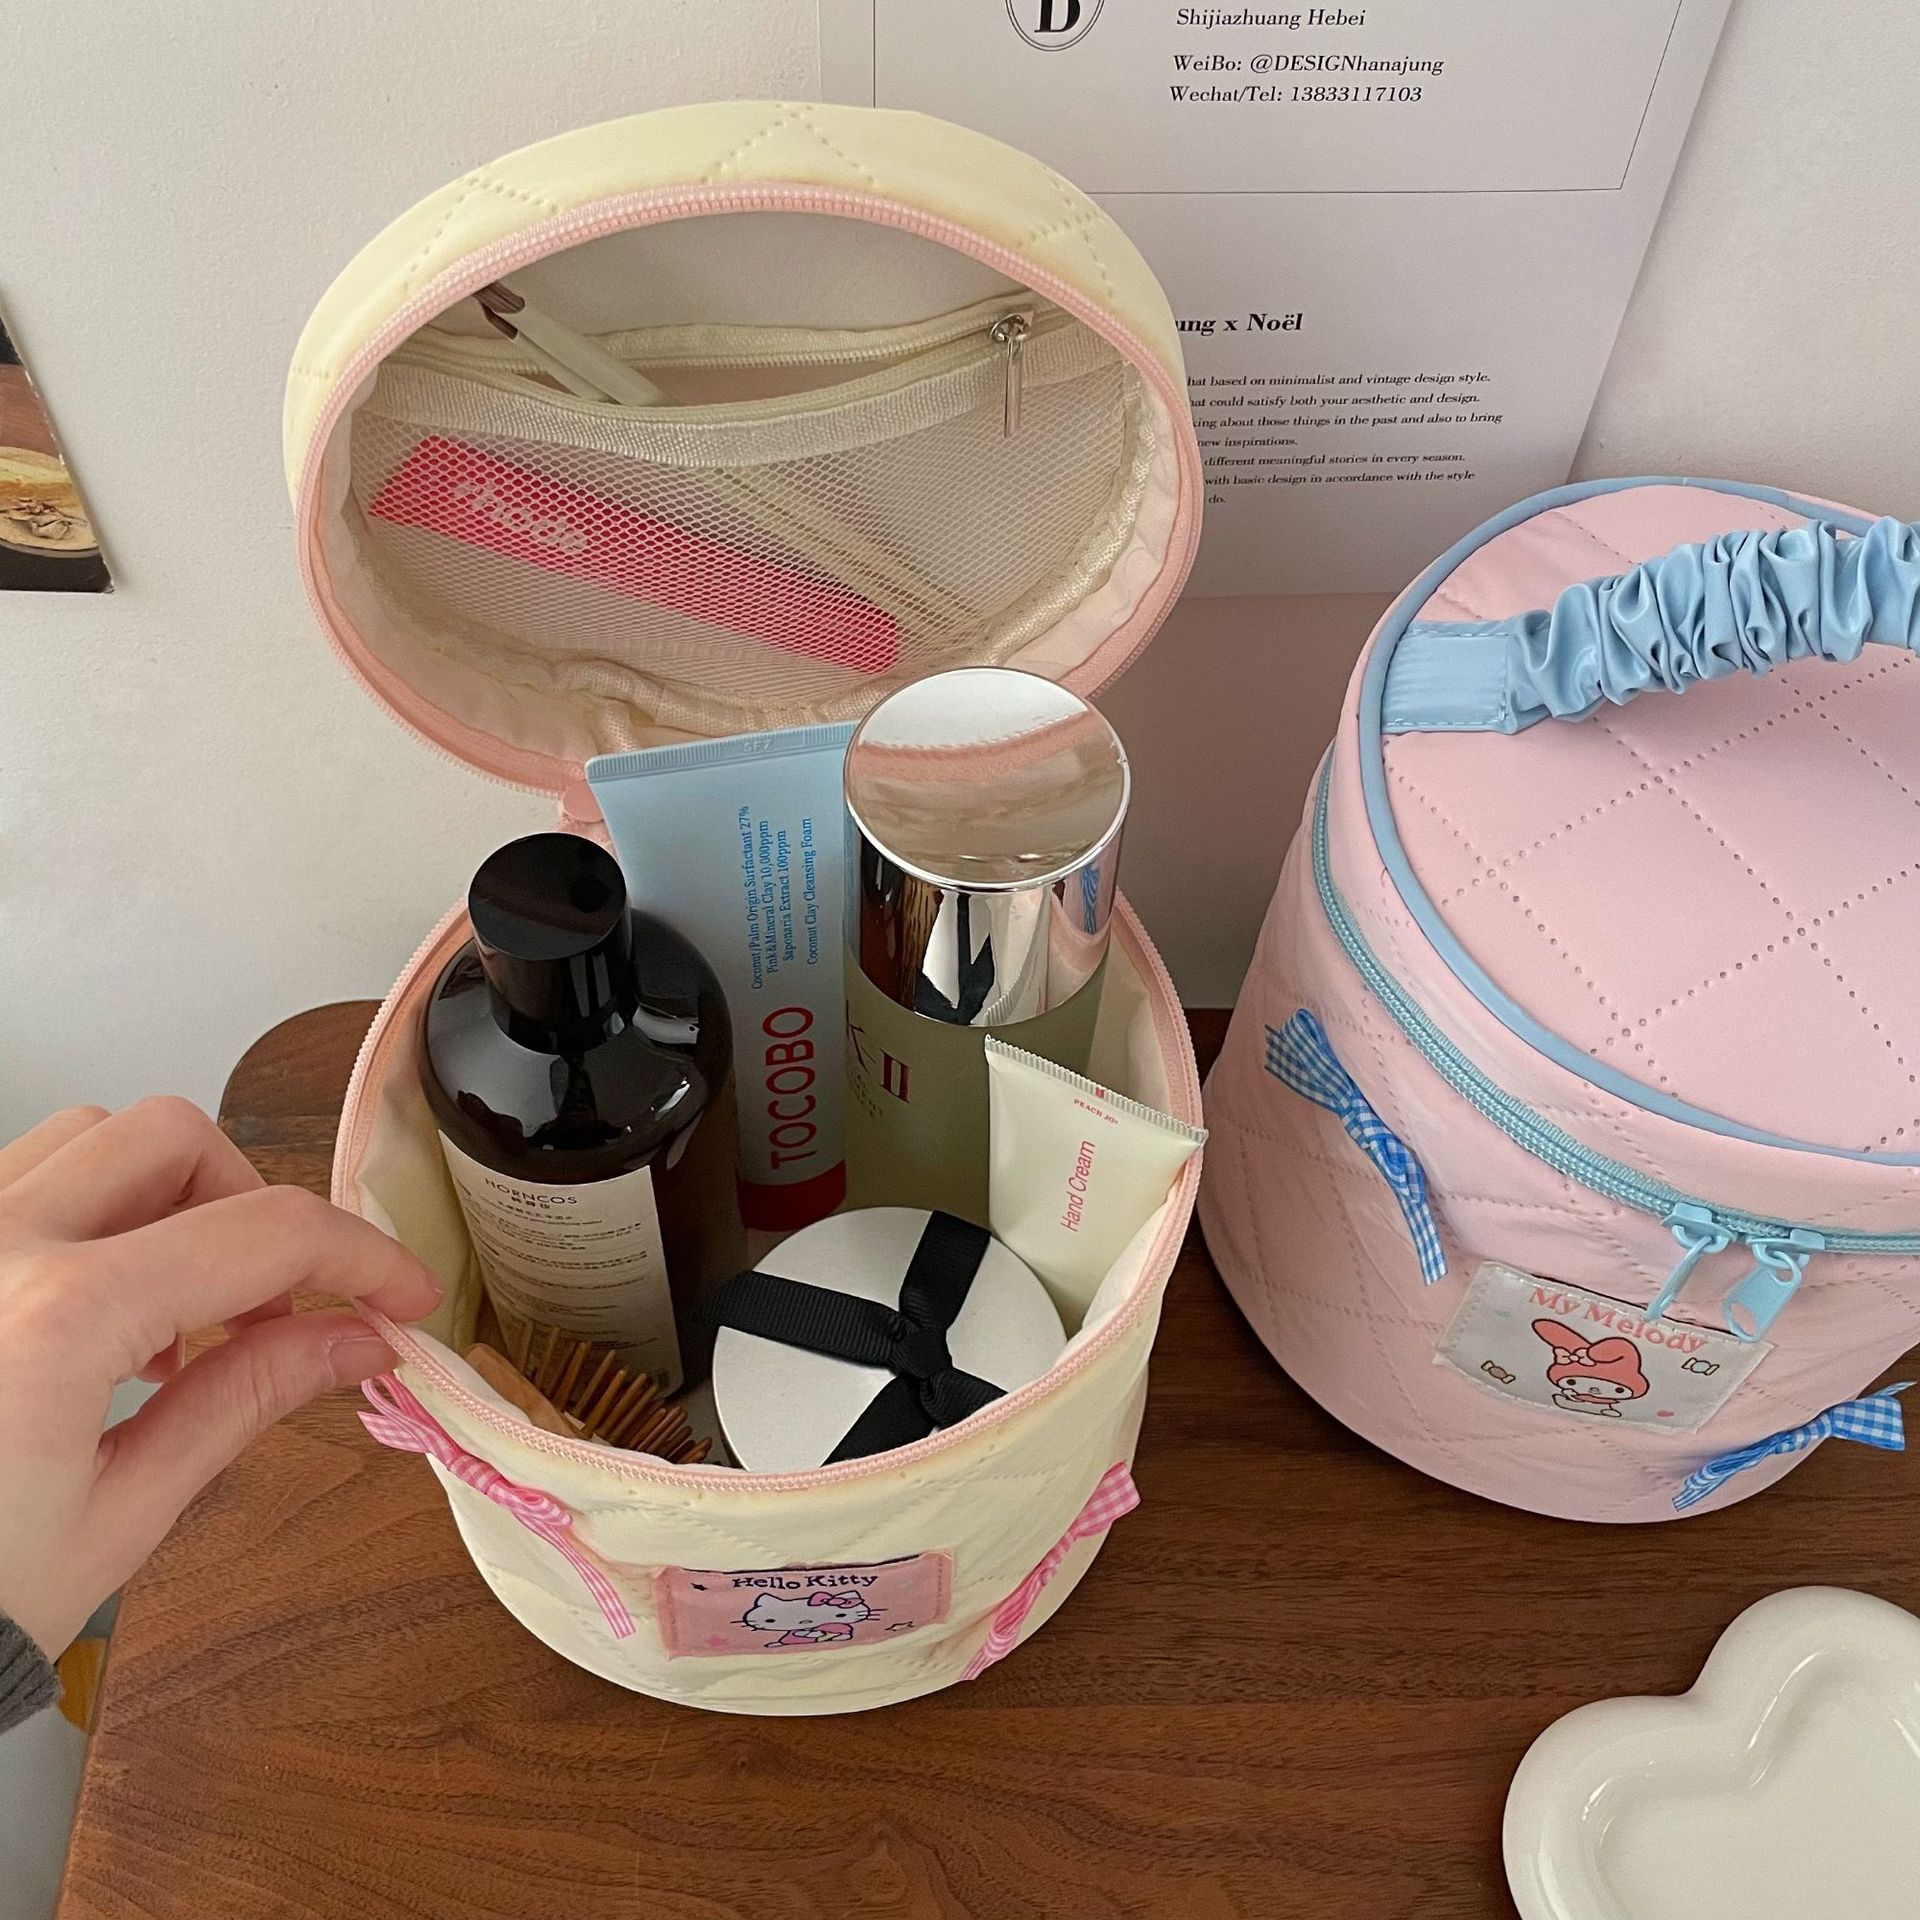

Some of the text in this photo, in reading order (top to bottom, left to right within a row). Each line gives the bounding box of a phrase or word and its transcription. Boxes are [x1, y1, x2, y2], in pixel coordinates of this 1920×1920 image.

[1176, 8, 1366, 29] Shijiazhuang Hebei
[1173, 54, 1445, 76] WeiBo: @DESIGNhanajung
[1170, 86, 1422, 103] Wechat/Tel: 13833117103
[1246, 313, 1303, 331] Noël
[1210, 376, 1246, 386] based
[1269, 375, 1335, 385] minimalist
[1338, 374, 1363, 384] and
[1366, 374, 1411, 386] vintage
[1414, 373, 1455, 385] design
[1459, 372, 1491, 384] style.
[1209, 396, 1244, 406] could
[1247, 396, 1287, 408] satisfy
[1290, 395, 1317, 406] both
[1320, 399, 1349, 408] your
[1351, 394, 1406, 405] aesthetic
[1410, 393, 1434, 403] and
[1436, 393, 1480, 404] design.
[1220, 416, 1254, 427] about
[1257, 416, 1289, 426] those
[1293, 416, 1330, 427] things
[1334, 415, 1346, 425] in
[1350, 415, 1369, 425] the
[1372, 416, 1398, 427] past
[1400, 414, 1424, 424] and
[1427, 413, 1452, 423] also
[1455, 414, 1467, 423] to
[1470, 413, 1503, 424] bring
[1224, 437, 1298, 448] inspirations.
[1204, 453, 1466, 466] different meaningful stories in every season.
[1205, 470, 1475, 486] with basic design in accordance with the style
[1208, 495, 1226, 503] do.
[738, 805, 751, 830] 27%
[742, 831, 756, 887] Surfactant
[759, 820, 773, 878] 10,000ppm
[762, 882, 776, 902] Clay
[777, 830, 796, 961] Saponaria Extract 100ppm
[801, 818, 819, 965] Coconut Clay Cleansing Foam
[747, 888, 760, 922] Origin
[762, 1006, 818, 1170] TOCOBO
[485, 1178, 578, 1204] HORNCOS
[1060, 1140, 1096, 1232] Hand Cream
[1529, 1287, 1709, 1354] My Melody
[732, 1574, 878, 1590] Hello Kitty
